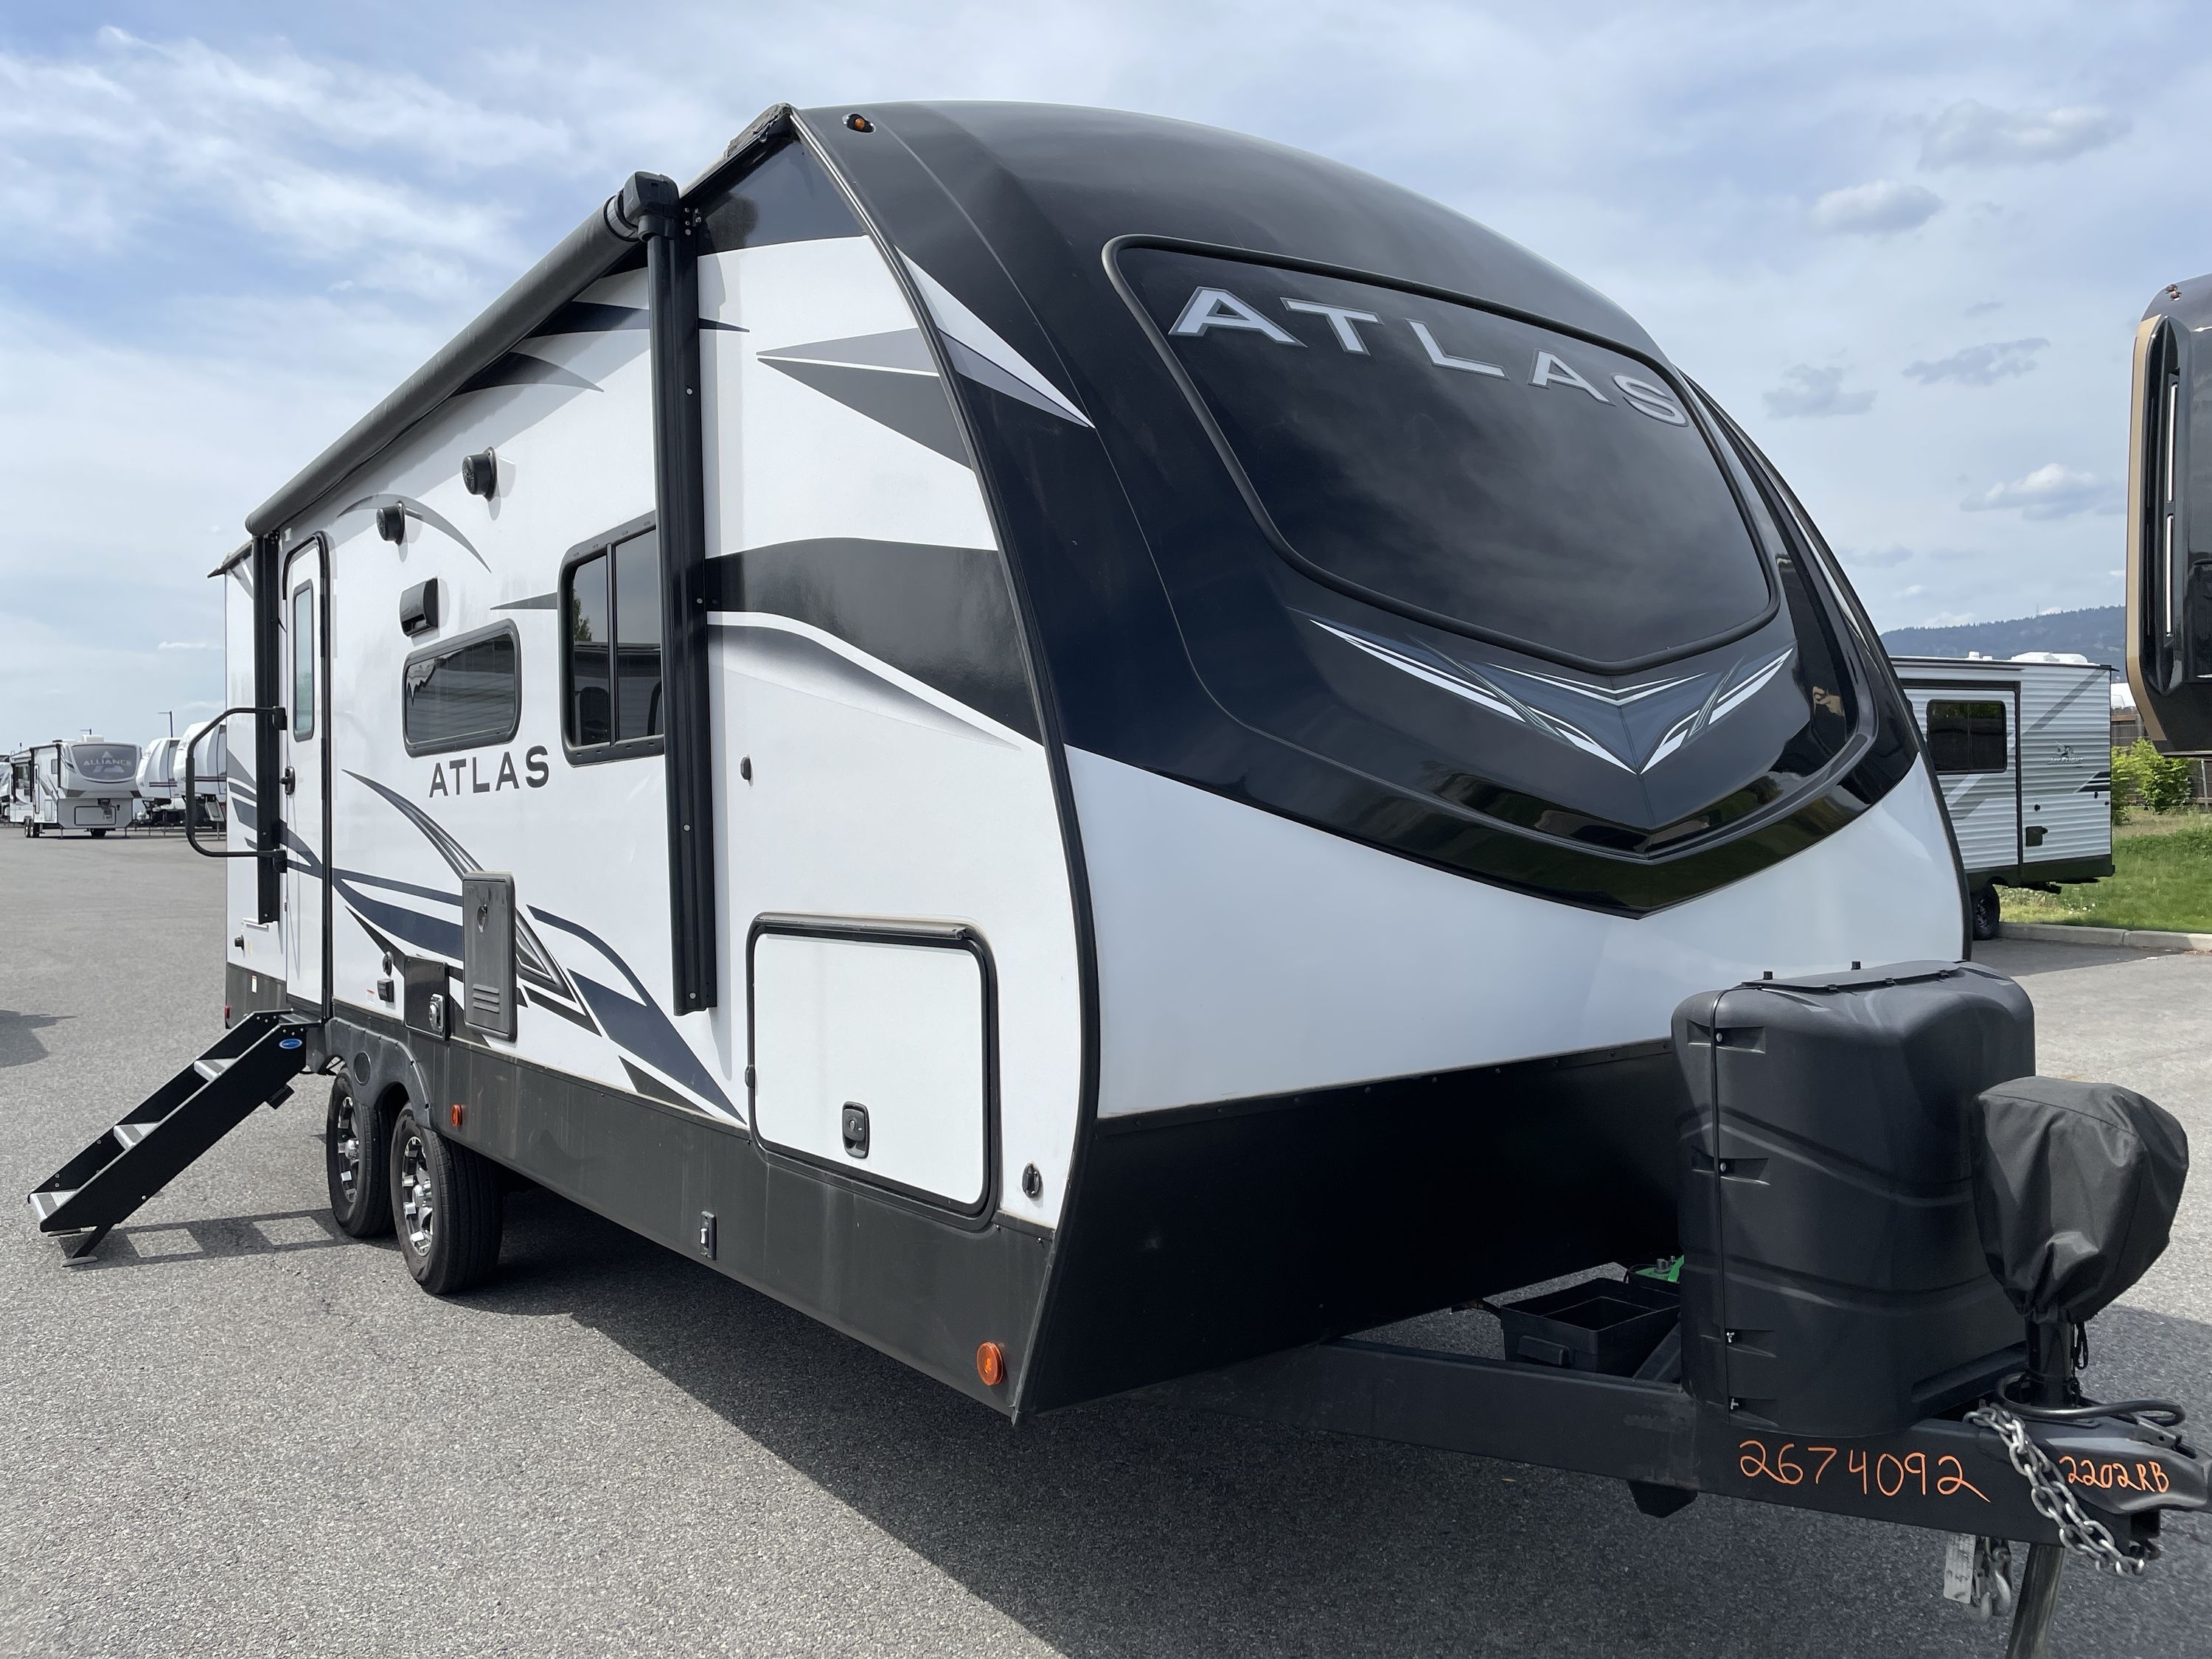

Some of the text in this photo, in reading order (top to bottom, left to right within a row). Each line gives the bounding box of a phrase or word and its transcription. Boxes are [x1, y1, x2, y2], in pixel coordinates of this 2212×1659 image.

[1169, 287, 1689, 427] ATLAS
[430, 745, 549, 798] ATLAS
[1739, 1439, 1991, 1503] 2674092
[2059, 1455, 2170, 1493] 2202RB
